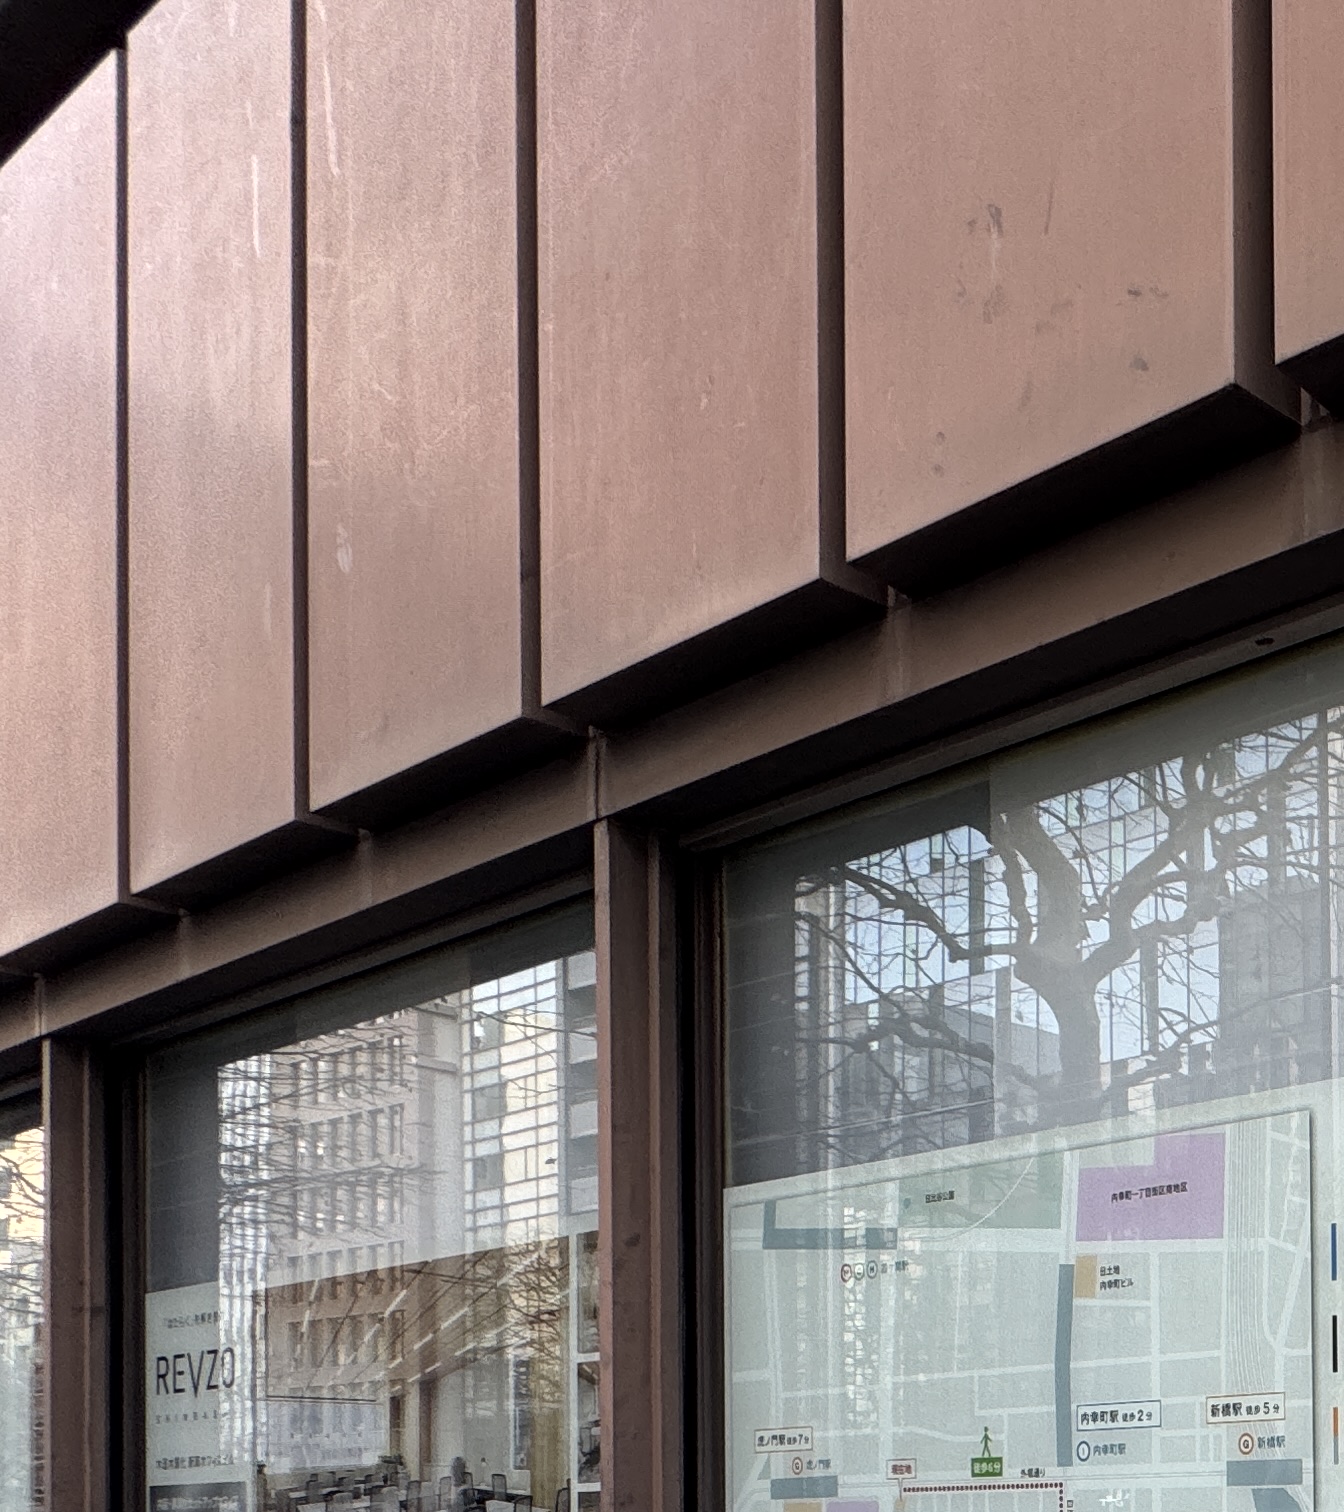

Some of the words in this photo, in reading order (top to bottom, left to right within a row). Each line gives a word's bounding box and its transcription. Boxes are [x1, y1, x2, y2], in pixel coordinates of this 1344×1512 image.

[155, 1346, 236, 1398] REVZO
[1081, 1409, 1120, 1425] 内幸町駅
[1210, 1402, 1243, 1418] 新橋駅
[1092, 1443, 1127, 1457] 内幸町駅
[1257, 1435, 1286, 1449] 新橋駅
